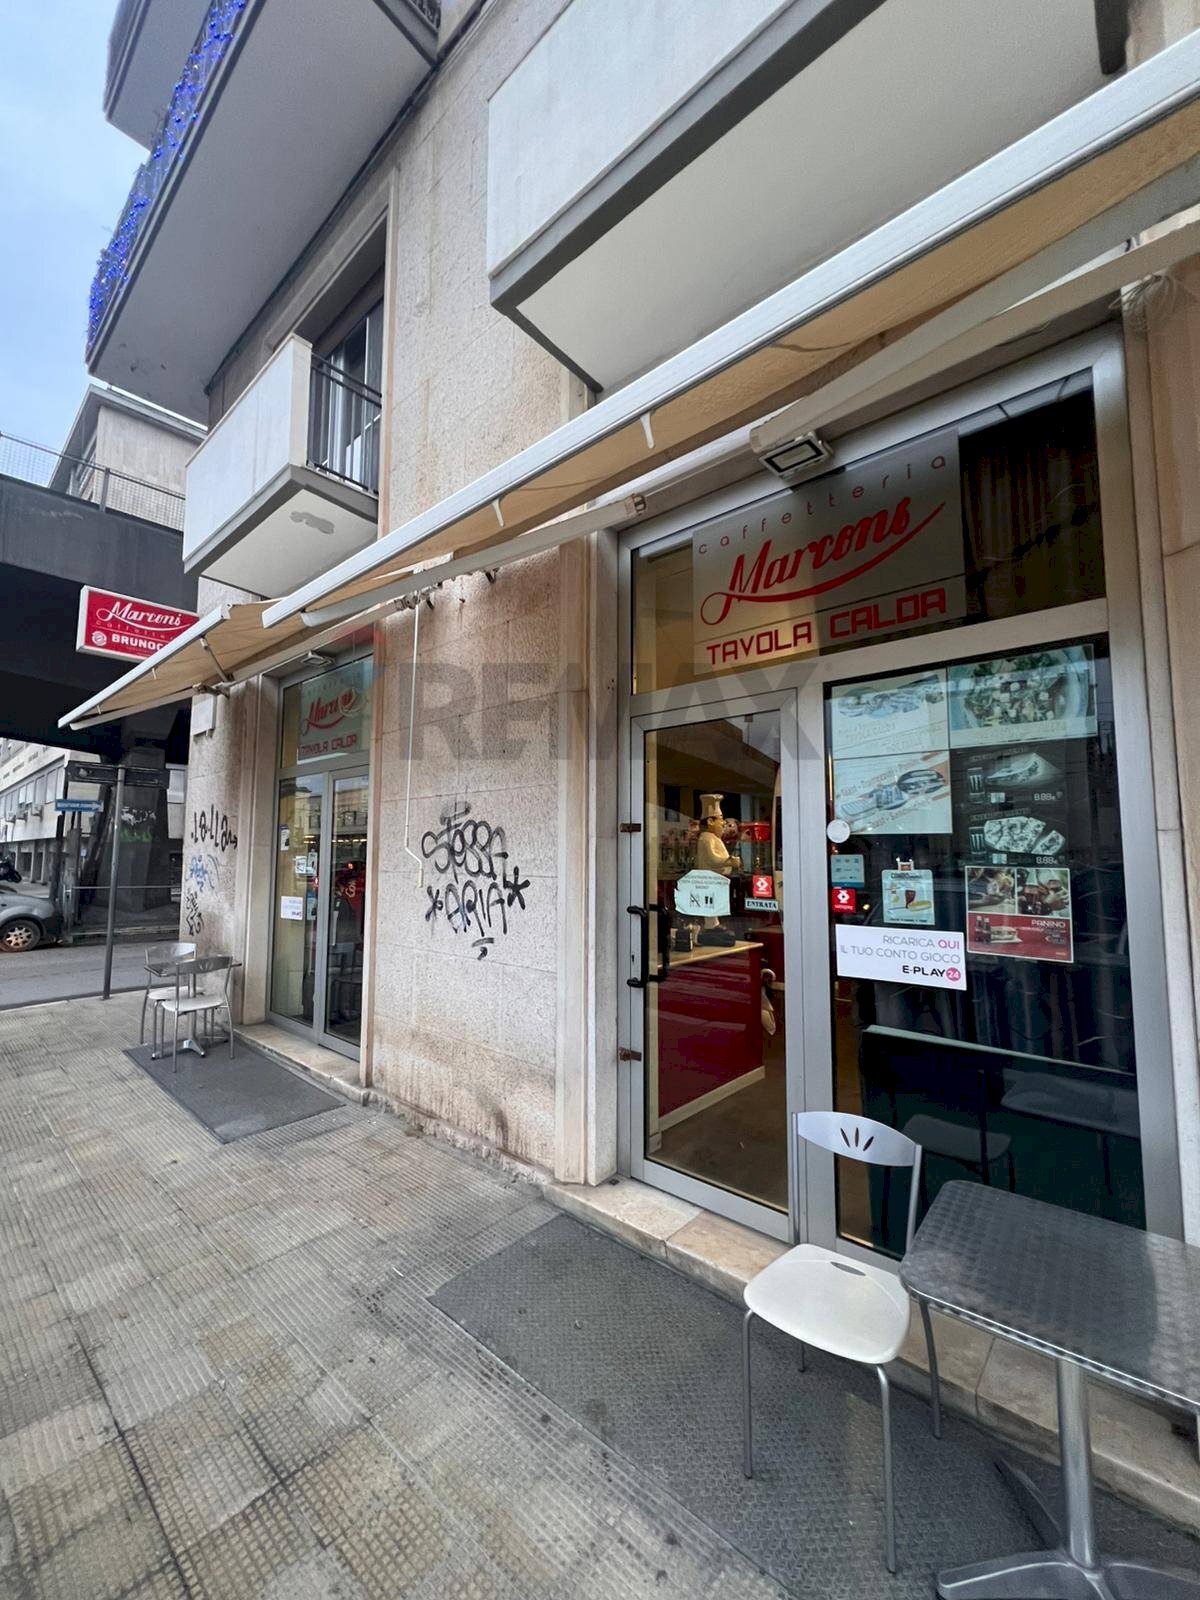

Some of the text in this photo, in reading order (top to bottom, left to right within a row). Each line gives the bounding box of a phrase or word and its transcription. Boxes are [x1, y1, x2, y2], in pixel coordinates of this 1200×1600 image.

[699, 455, 947, 555] caffetteria
[96, 601, 190, 632] Marconi
[706, 587, 947, 665] TAVOLA CALDA
[746, 900, 777, 909] ENTRATA
[840, 945, 961, 964] IL TUO CONTO GIOCO
[882, 935, 960, 950] RICARICA QUI
